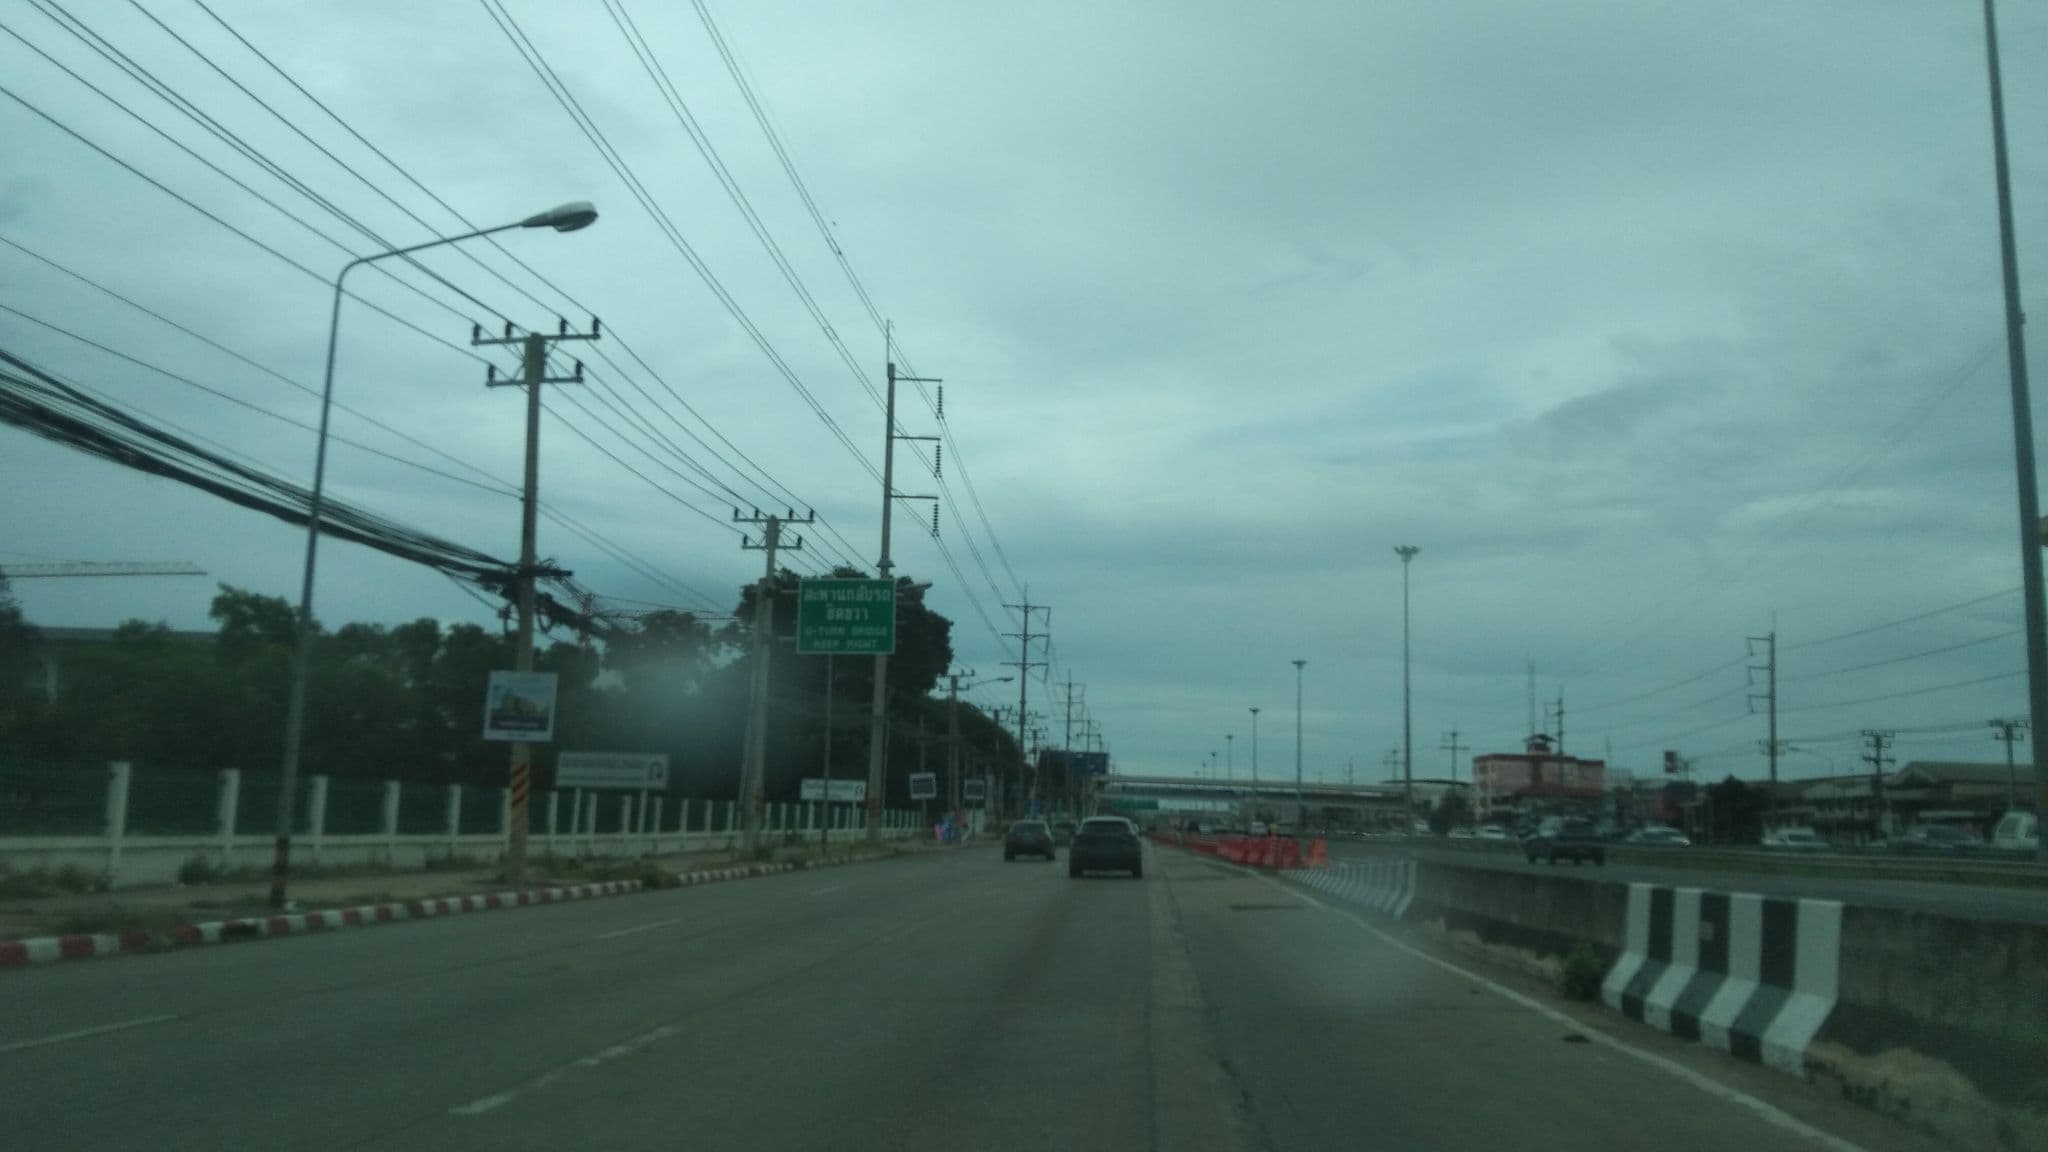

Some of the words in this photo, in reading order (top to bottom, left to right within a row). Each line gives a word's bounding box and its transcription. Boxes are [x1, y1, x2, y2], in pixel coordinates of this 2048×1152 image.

[804, 584, 890, 601] สะพานกลับรถ
[826, 603, 868, 620] ชิดขวา
